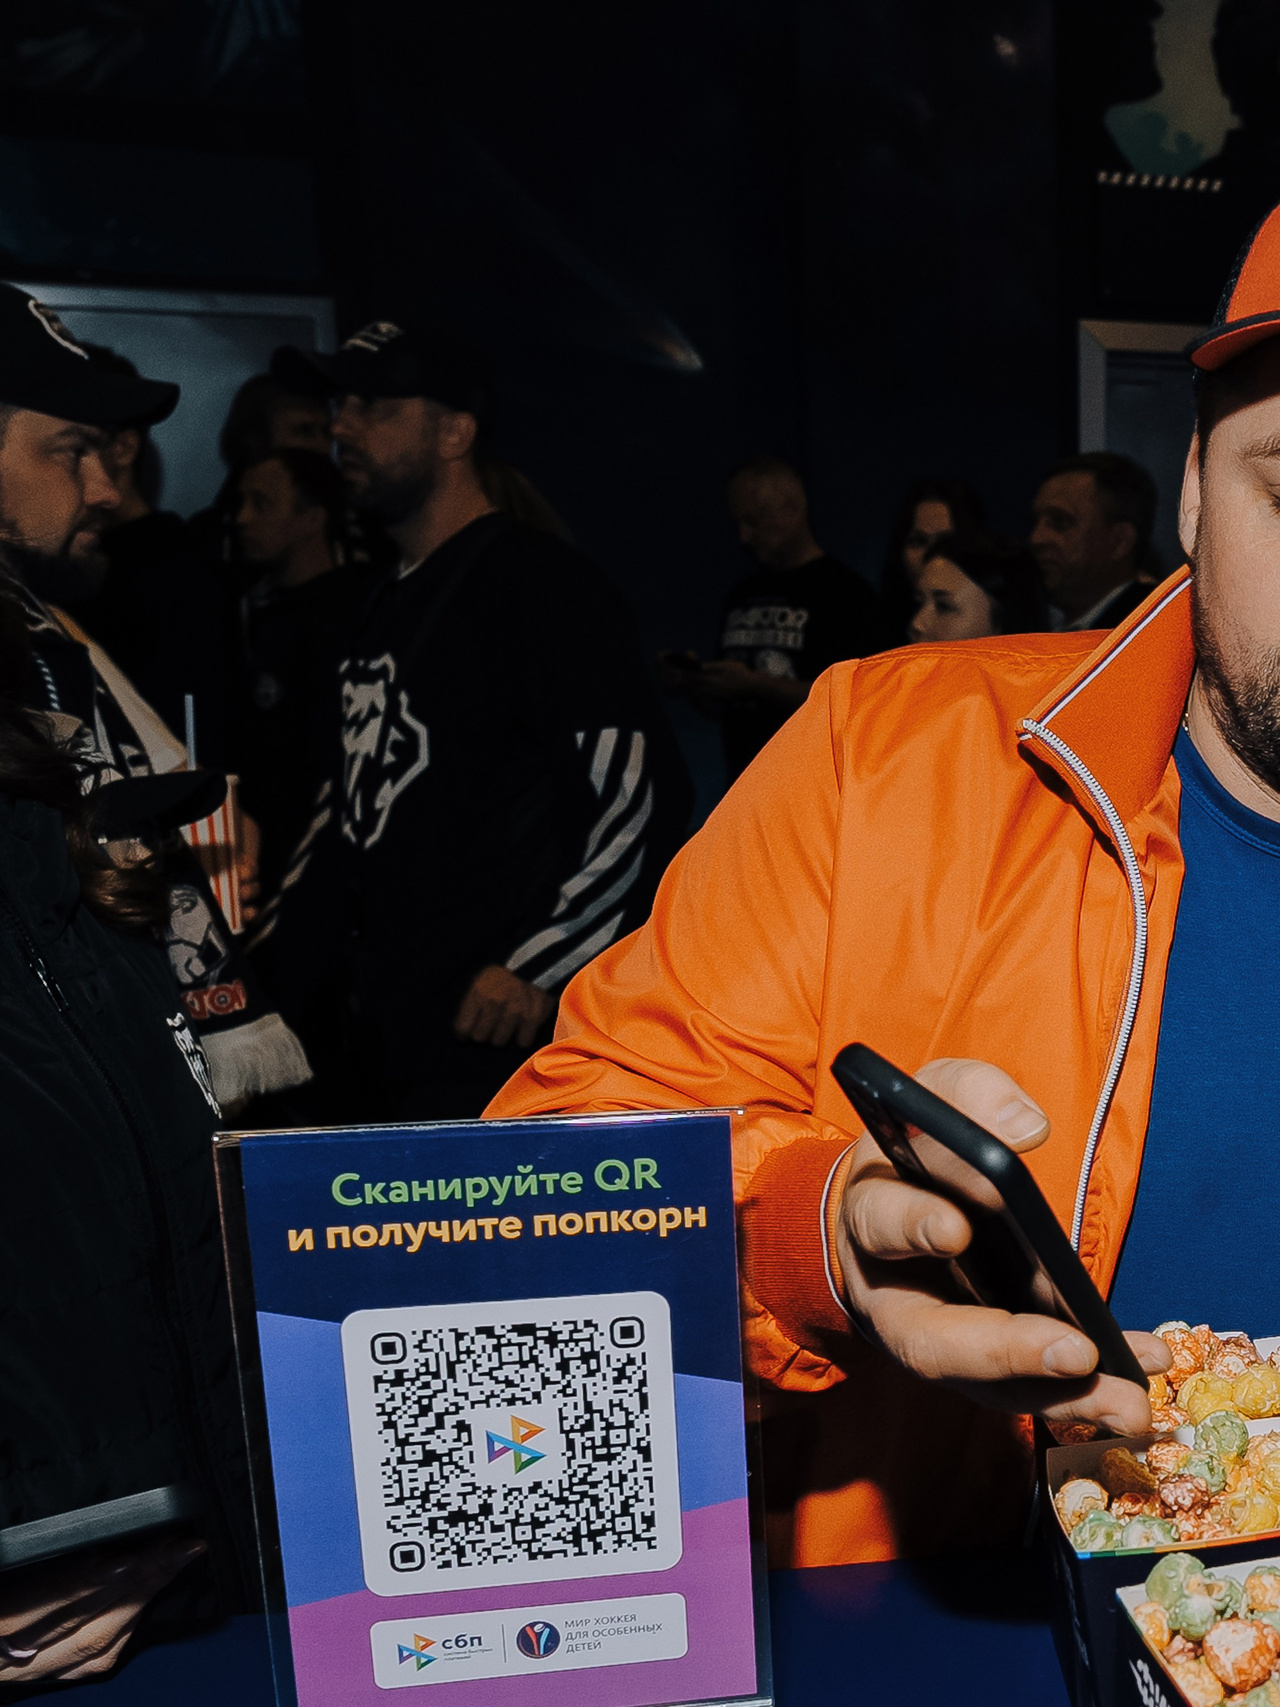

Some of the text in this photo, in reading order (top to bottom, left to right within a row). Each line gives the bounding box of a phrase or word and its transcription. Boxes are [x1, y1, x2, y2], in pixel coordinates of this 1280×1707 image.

[331, 1157, 663, 1208] Сканируйте QR
[287, 1206, 708, 1254] и получите попкорн
[564, 1613, 638, 1629] МИР ХОККЕЯ
[441, 1633, 483, 1650] сбп
[564, 1623, 664, 1642] ДЛЯ ОСОБЕННЫХ
[565, 1640, 603, 1654] ДЕТЕЙ
